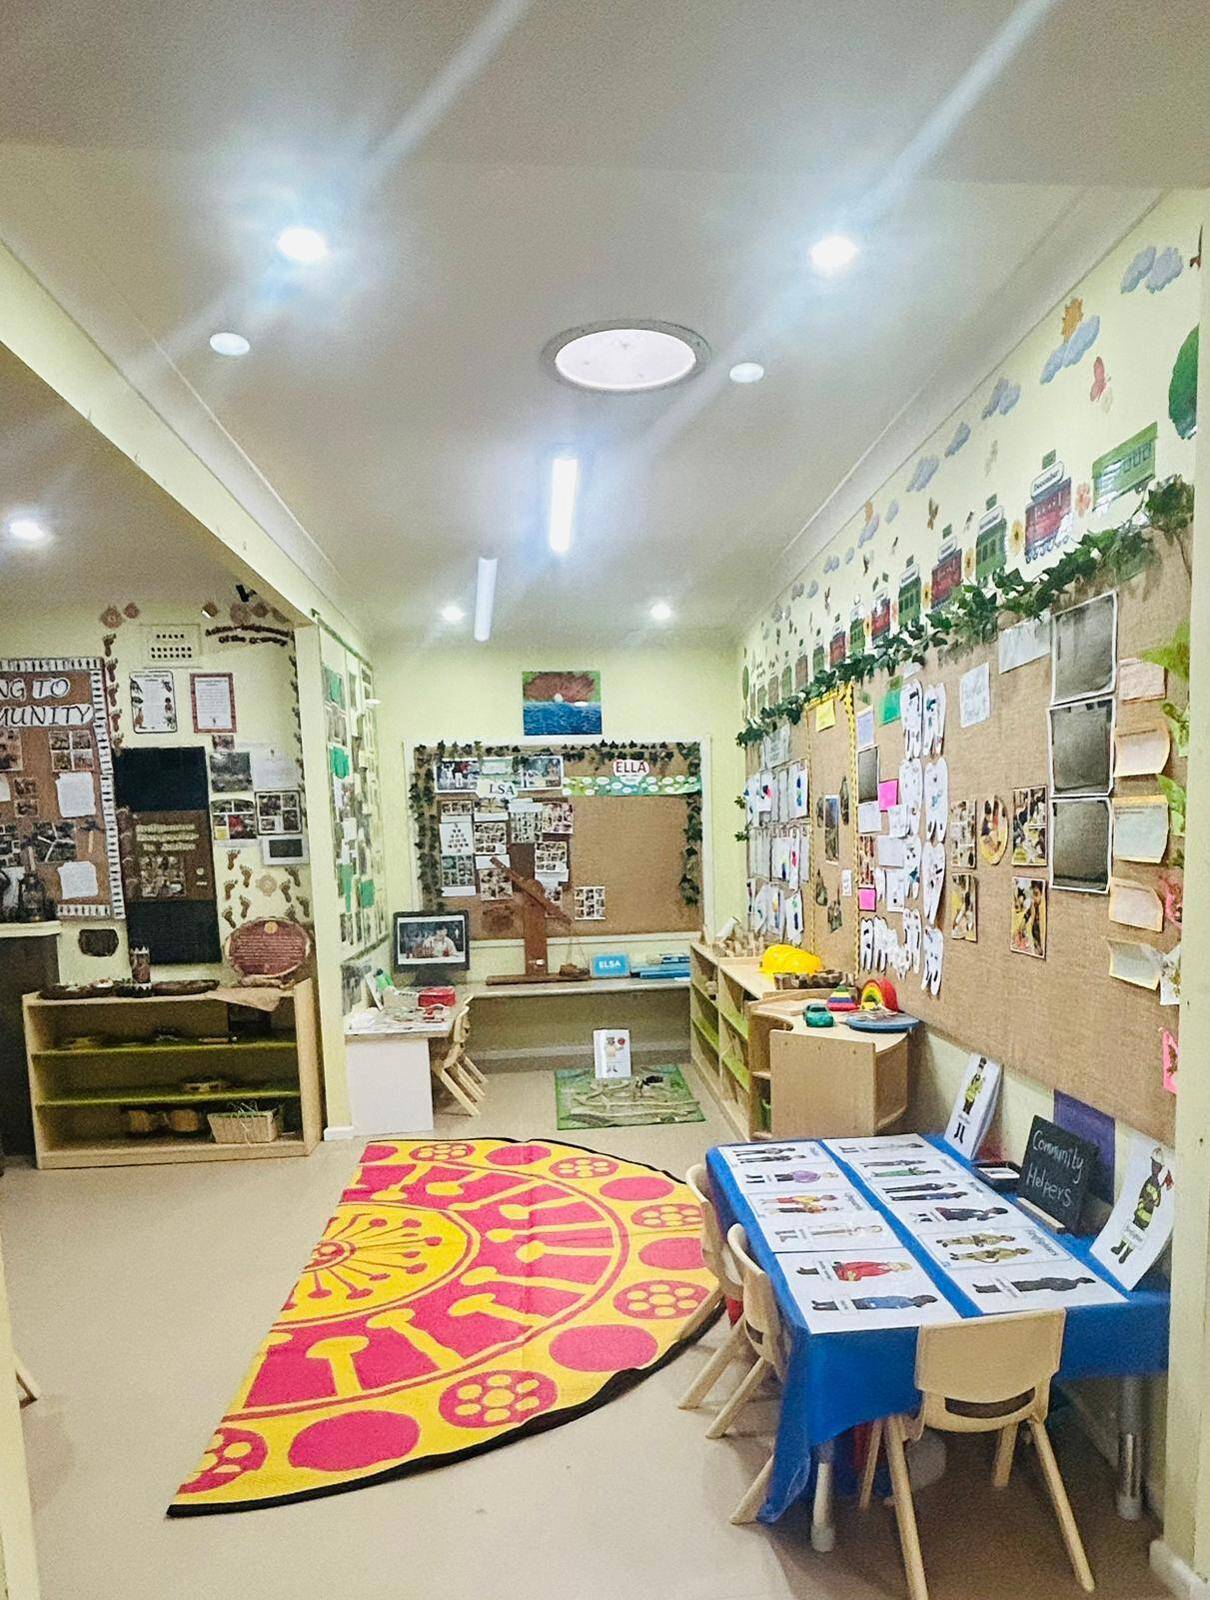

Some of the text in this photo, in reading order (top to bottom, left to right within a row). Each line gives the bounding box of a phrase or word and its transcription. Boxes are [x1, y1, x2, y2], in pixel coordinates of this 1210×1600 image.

[36, 679, 69, 697] TO
[615, 761, 646, 774] ELLA
[598, 960, 622, 969] ELSA
[1033, 1130, 1083, 1184] Community
[1026, 1162, 1072, 1207] Helpers
